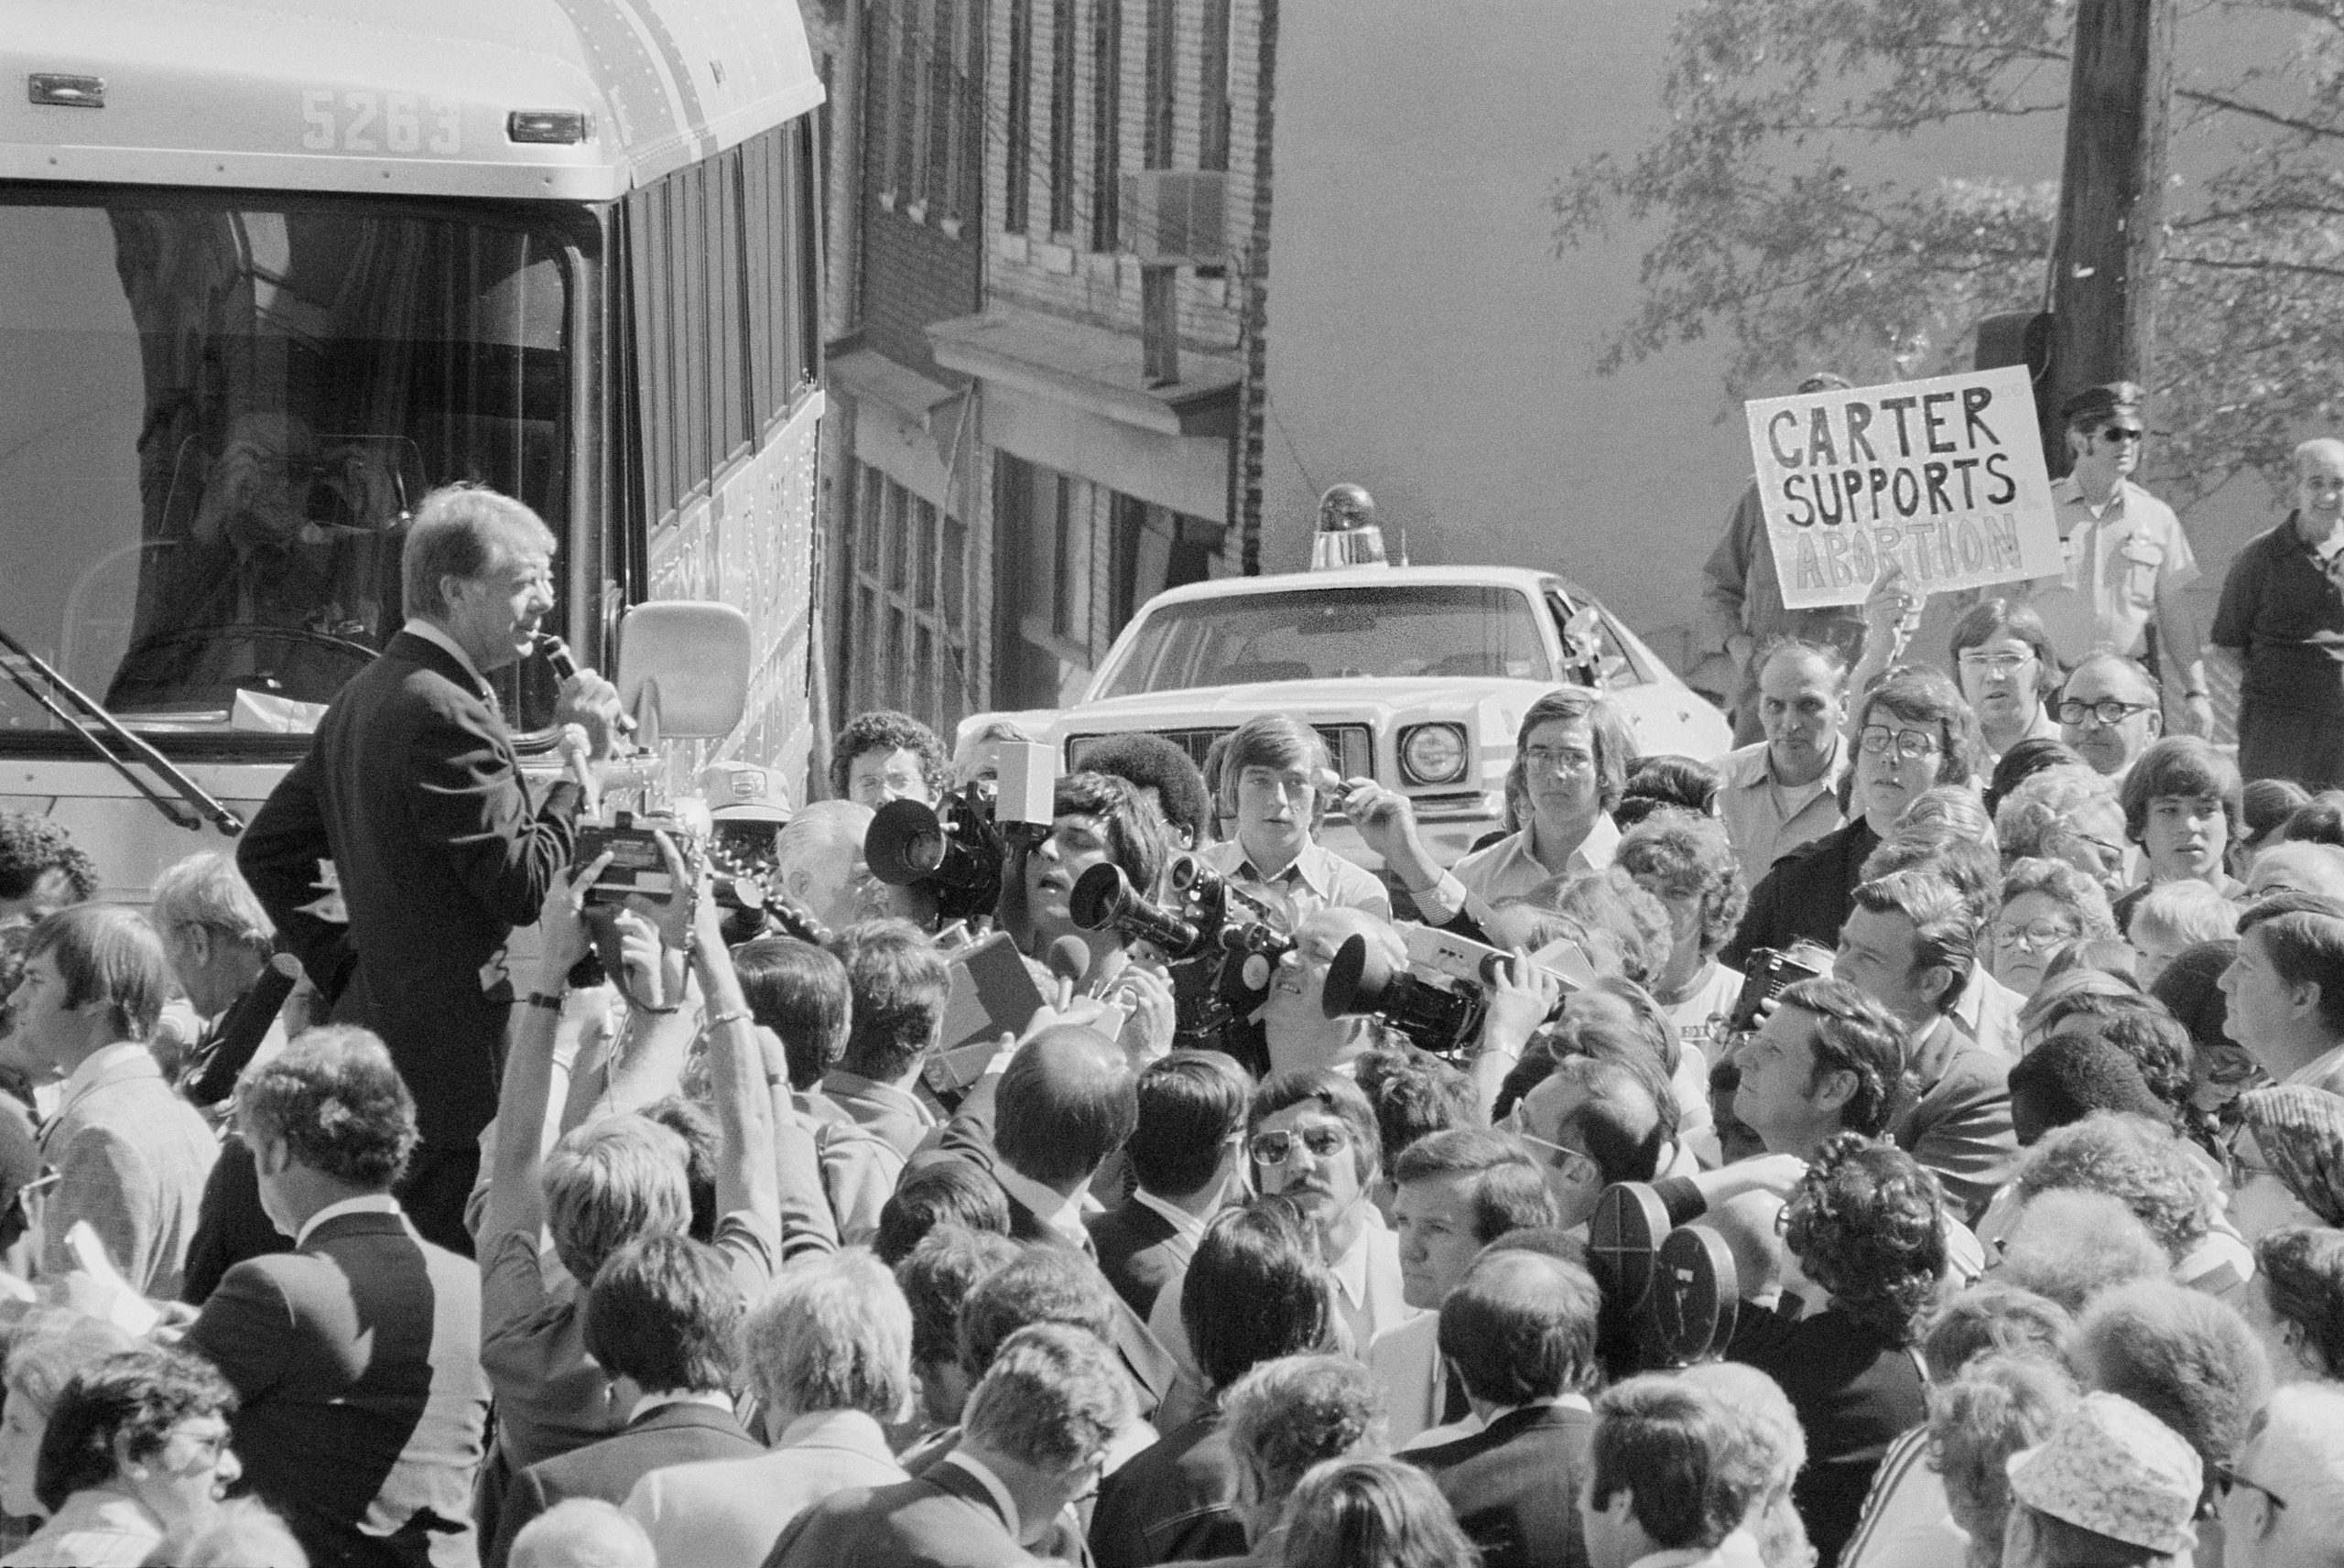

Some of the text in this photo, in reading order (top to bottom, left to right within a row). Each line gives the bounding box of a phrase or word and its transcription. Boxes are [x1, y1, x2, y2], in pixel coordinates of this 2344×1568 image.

[301, 90, 461, 154] 5263
[1768, 386, 2001, 469] CARTER
[1783, 453, 2017, 528] SUPPORTS
[1796, 514, 2024, 590] ABORTION
